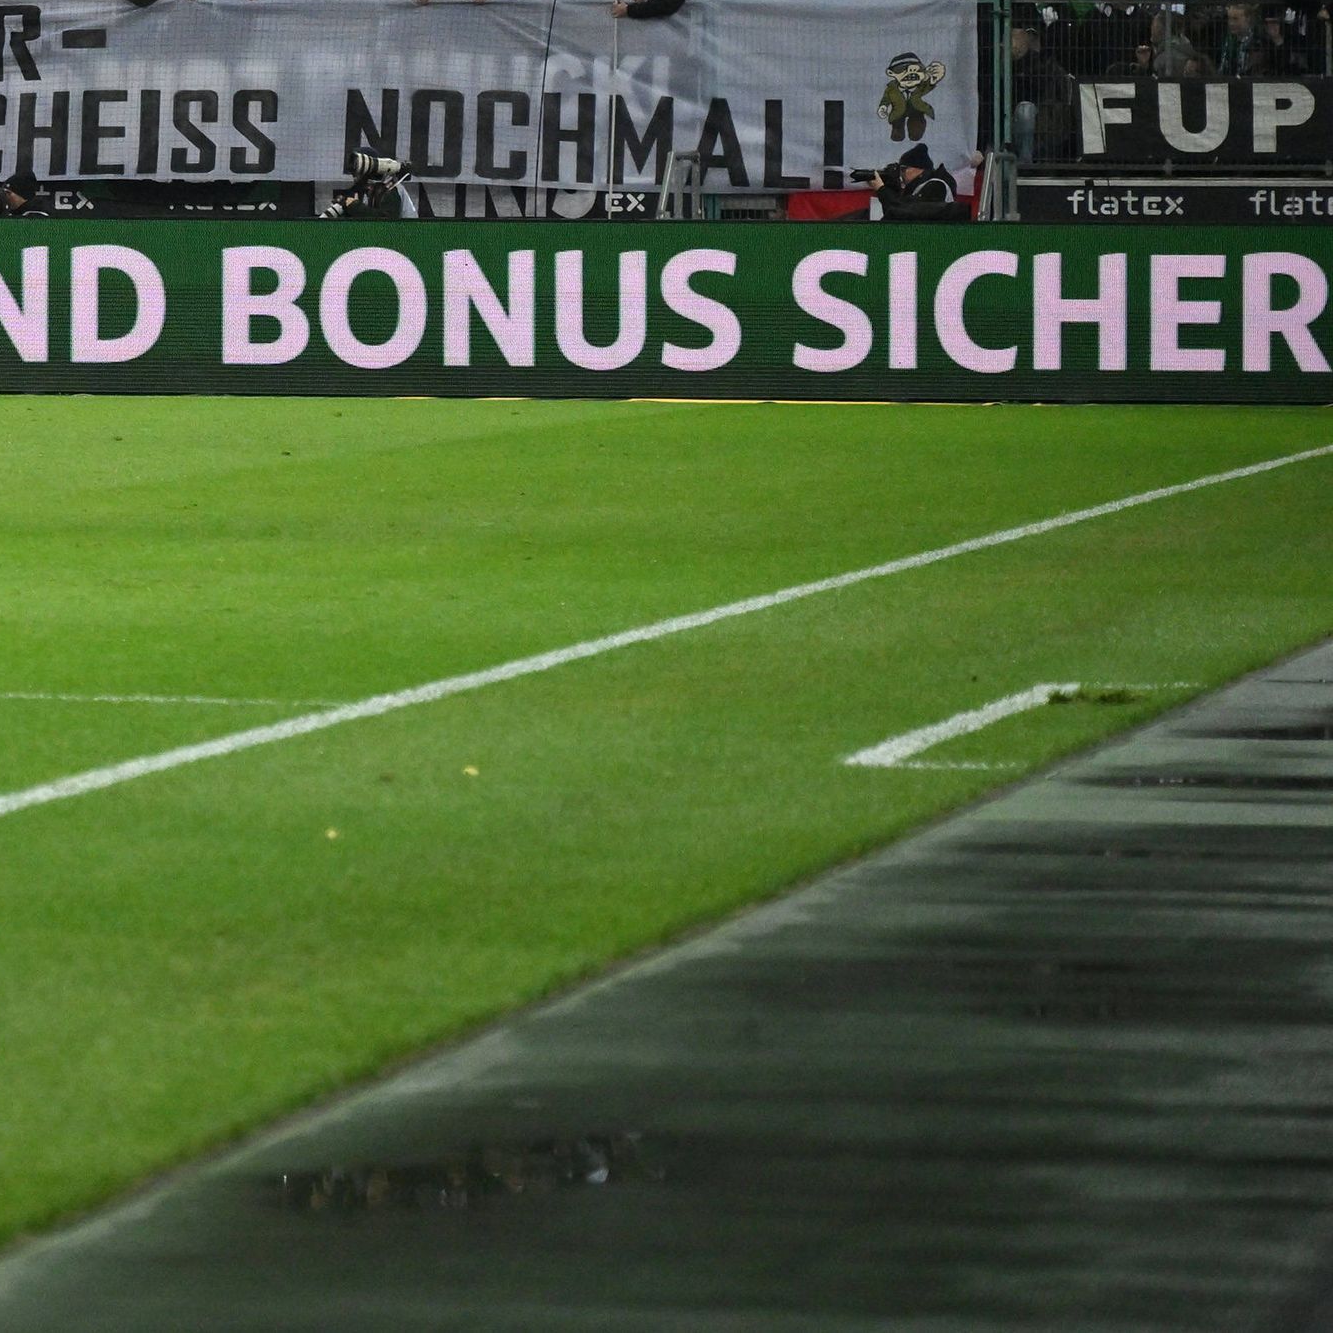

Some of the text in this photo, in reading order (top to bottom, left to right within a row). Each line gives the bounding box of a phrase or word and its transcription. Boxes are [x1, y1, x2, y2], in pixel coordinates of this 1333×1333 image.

[344, 89, 846, 191] NOCHMAL!
[1079, 82, 1315, 154] FUP
[220, 247, 743, 372] BONUS
[792, 251, 1330, 374] SICHER
